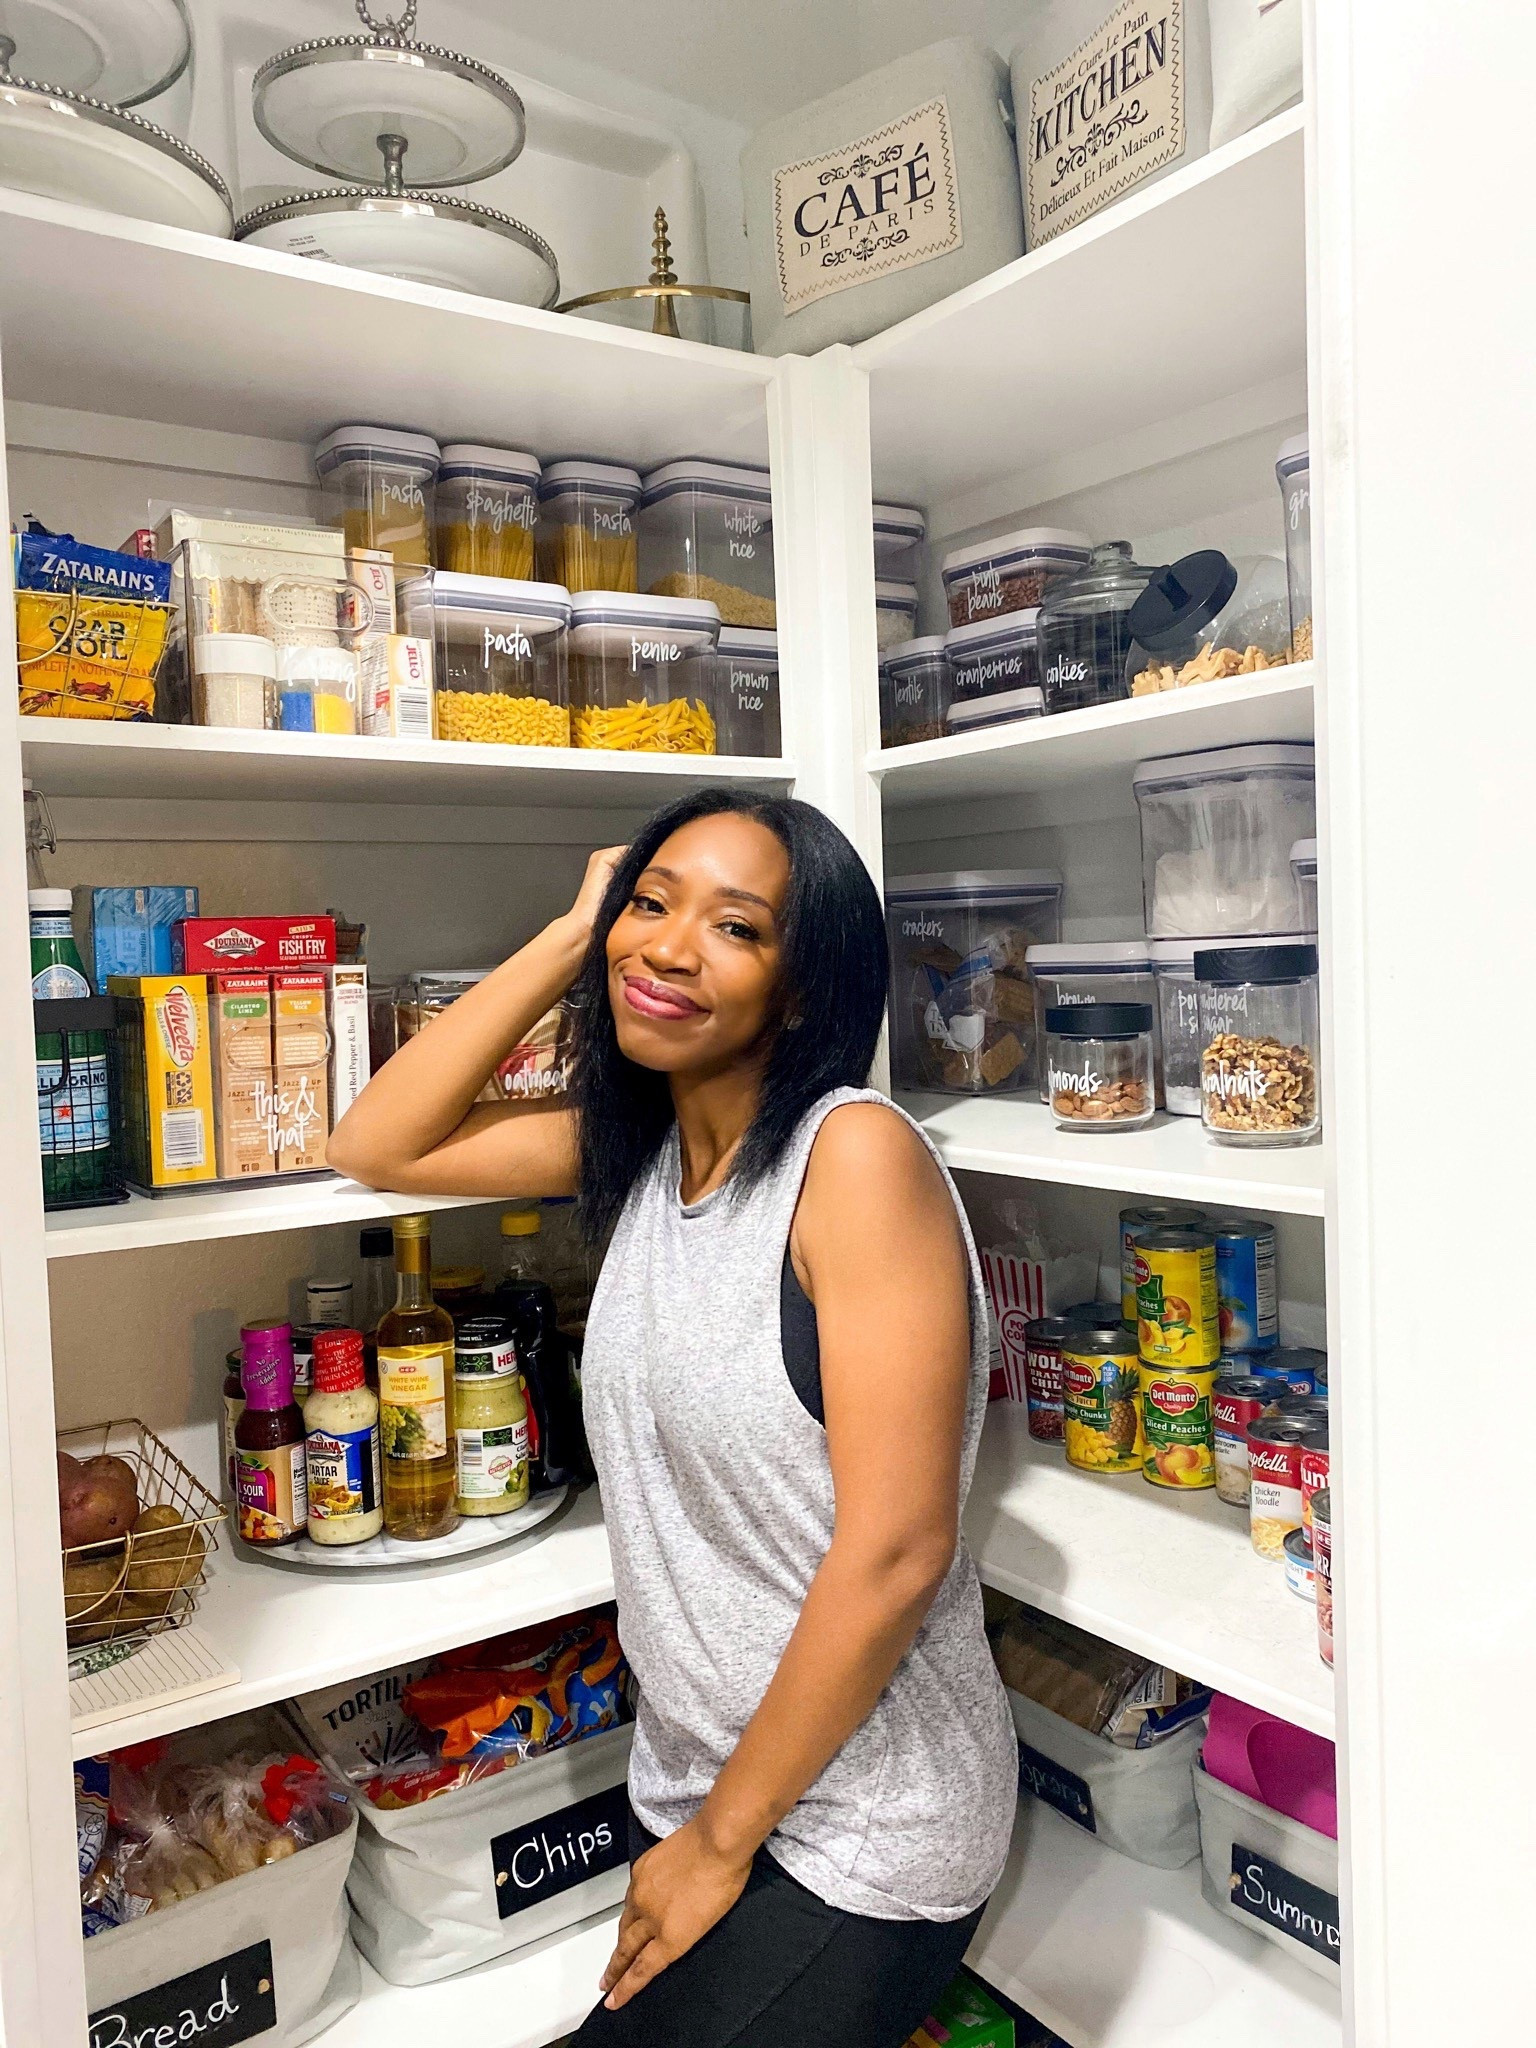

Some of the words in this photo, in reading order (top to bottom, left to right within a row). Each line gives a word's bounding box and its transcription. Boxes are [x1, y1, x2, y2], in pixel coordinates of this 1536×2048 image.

[1054, 73, 1076, 100] Pour
[1077, 48, 1103, 77] Cuire
[1106, 32, 1119, 52] Le
[1123, 10, 1149, 39] Pain
[1034, 17, 1167, 164] KITCHEN
[1084, 169, 1096, 190] Et
[1121, 125, 1165, 162] Maison
[793, 142, 936, 239] CAFÉ
[799, 234, 831, 258] DE
[848, 199, 936, 241] PARIS
[381, 477, 425, 514] pasta
[466, 490, 538, 533] spaghetti
[593, 506, 632, 536] pasta
[724, 508, 761, 536] white
[729, 533, 756, 560] rice
[40, 552, 155, 591] ZATARAIN'S
[972, 562, 1001, 597] pinto
[967, 586, 1005, 620] beans
[49, 615, 126, 641] CRAB
[54, 634, 128, 661] BOIL
[484, 624, 532, 668] pasta
[631, 636, 682, 671] penne
[730, 661, 769, 692] brown
[956, 655, 1023, 689] cranberries
[737, 686, 764, 711] rice
[893, 675, 924, 707] lentils
[902, 911, 944, 941] crackers
[214, 937, 256, 950] LOUISIANA
[279, 940, 304, 956] FISH
[306, 939, 326, 955] FRY
[282, 977, 323, 985] ZATARAIN'S
[165, 992, 196, 1062] Velveeta
[347, 1015, 356, 1034] Basil
[349, 1043, 358, 1070] Pepper
[348, 1071, 357, 1085] Red
[1049, 1058, 1103, 1097] lmonds
[1202, 1060, 1271, 1100] walnuts
[249, 1080, 294, 1122] this
[294, 1075, 320, 1122] &
[261, 1112, 310, 1155] that
[1010, 1320, 1023, 1330] PO
[1027, 1351, 1062, 1371] WOL
[1030, 1369, 1062, 1380] BRAN
[260, 1370, 277, 1386] Added
[391, 1384, 427, 1392] VINEGAR
[1031, 1376, 1062, 1390] CHIL
[1069, 1371, 1092, 1384] Monte
[1152, 1389, 1164, 1400] Del
[1166, 1392, 1195, 1402] Monte
[1080, 1409, 1107, 1420] Chunks
[1146, 1418, 1167, 1430] Sliced
[1170, 1422, 1206, 1433] Peaches
[309, 1464, 338, 1477] TARTAR
[314, 1477, 330, 1485] SAUCE
[243, 1484, 264, 1497] SOUR
[1255, 1486, 1280, 1497] Chicken
[1256, 1496, 1279, 1506] Noodle
[511, 1822, 613, 1889] Chips
[88, 1975, 240, 2048] Bread
